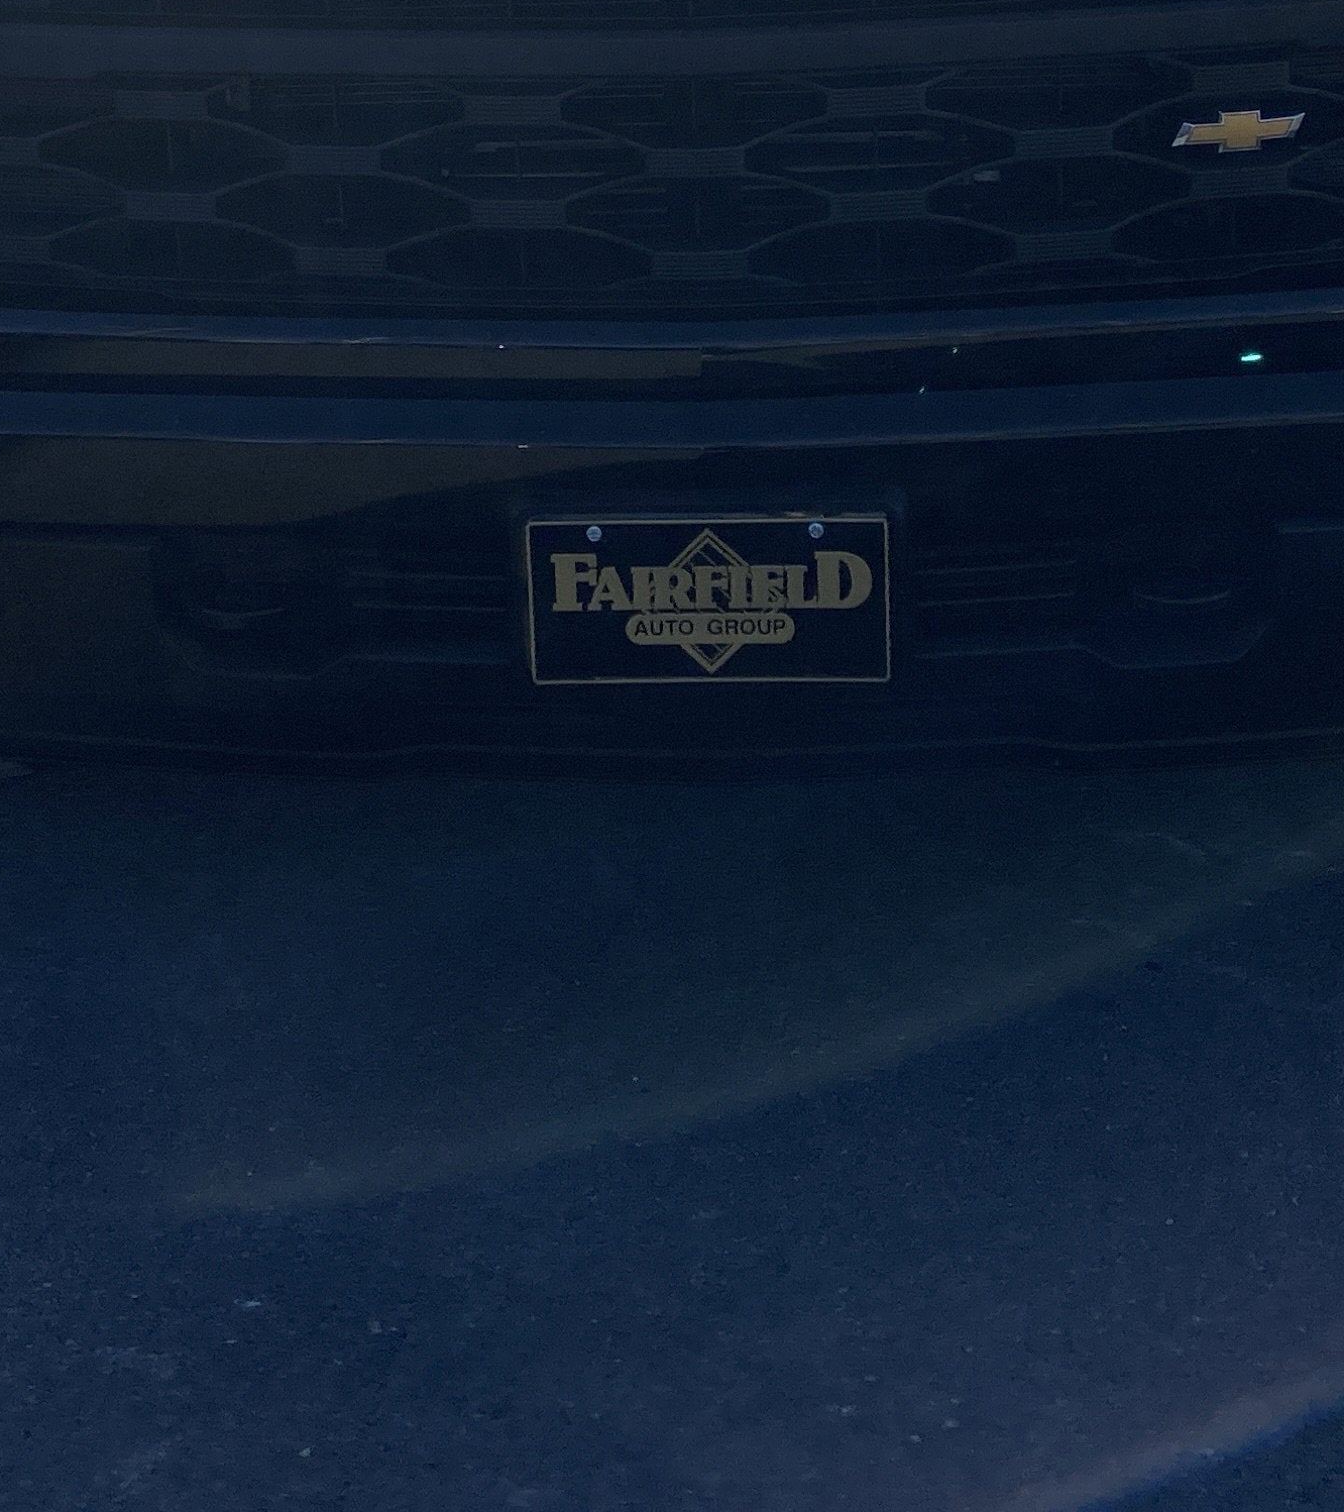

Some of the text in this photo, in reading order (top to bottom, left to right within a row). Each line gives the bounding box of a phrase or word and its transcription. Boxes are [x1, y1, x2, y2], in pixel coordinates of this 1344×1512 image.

[549, 549, 873, 613] FAIRFIELD
[633, 617, 787, 637] AUTO GROUP
